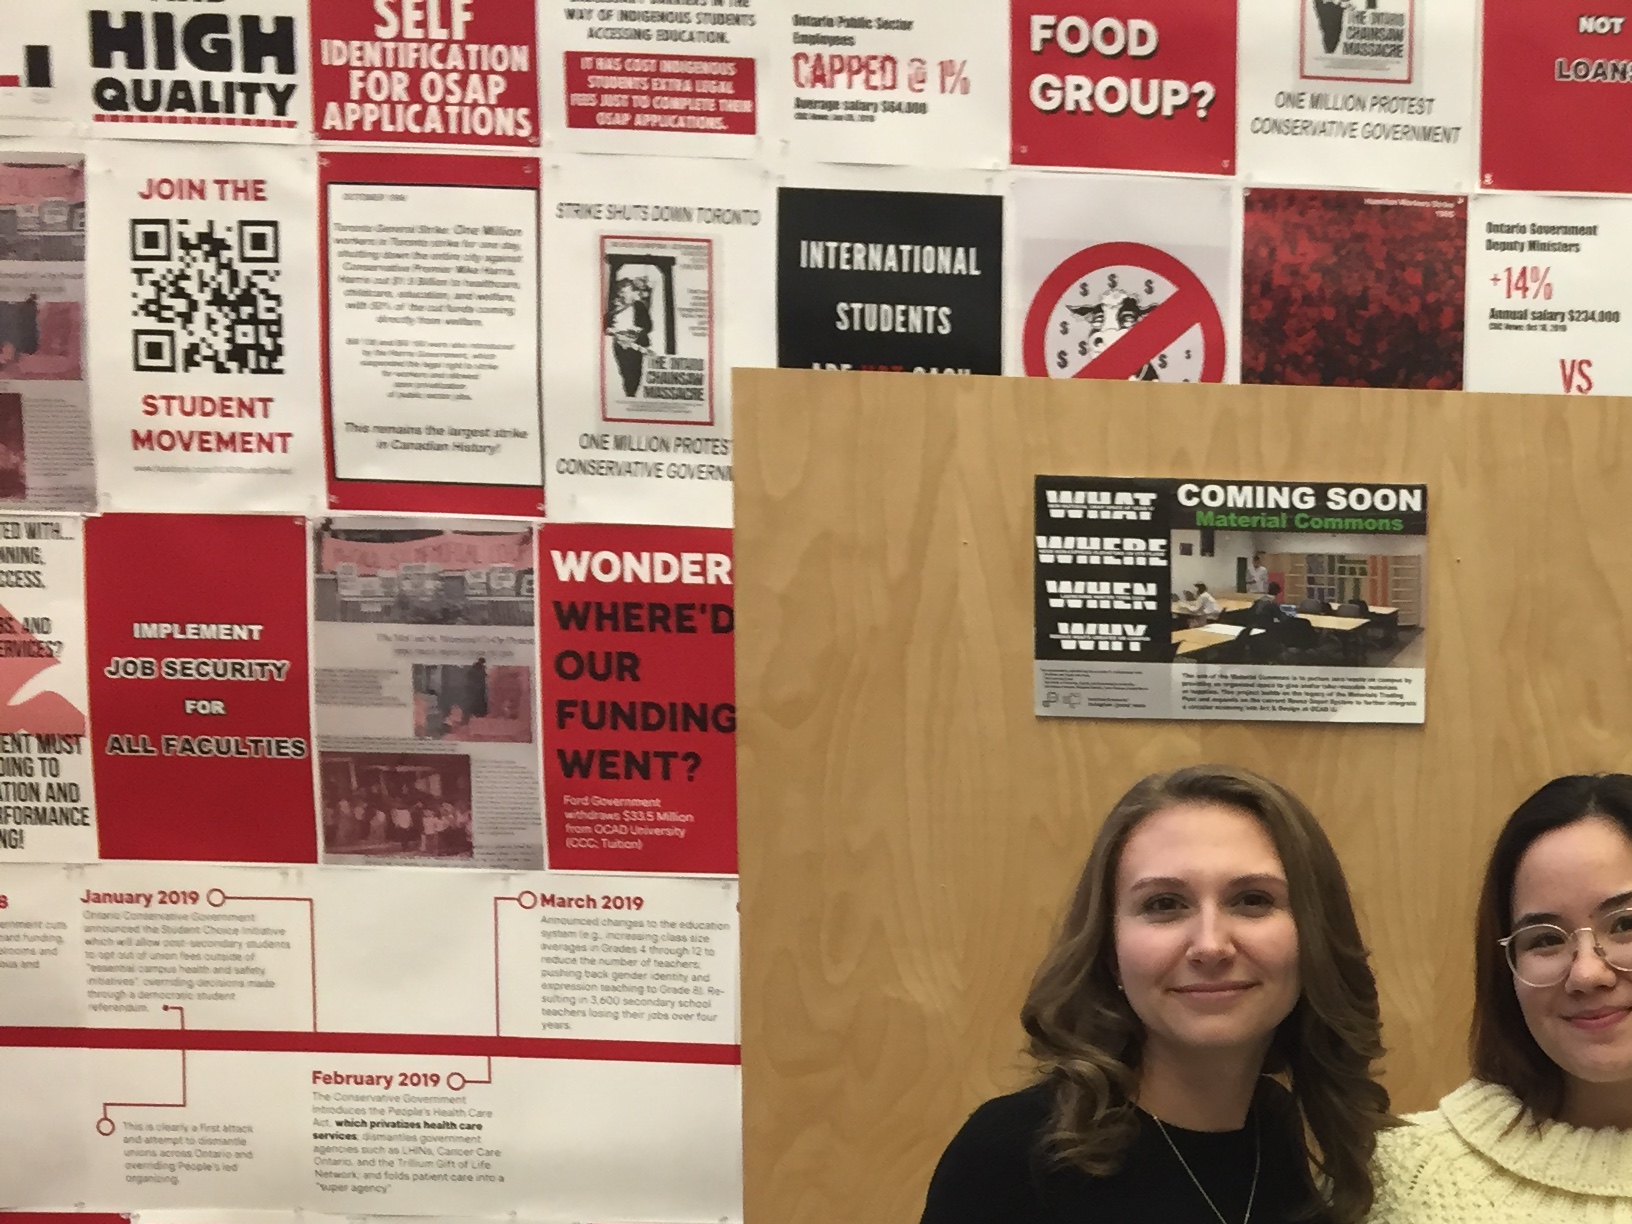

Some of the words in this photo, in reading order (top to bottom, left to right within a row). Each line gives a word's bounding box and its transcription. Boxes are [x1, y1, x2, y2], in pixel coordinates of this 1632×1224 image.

[138, 178, 206, 200] JOIN
[213, 179, 267, 201] THE
[143, 395, 274, 418] STUDENT
[131, 429, 292, 453] MOVEMENT
[1178, 484, 1315, 509] COMING
[1327, 488, 1421, 511] SOON
[1196, 511, 1288, 528] Material
[1295, 513, 1403, 530] Commons
[551, 551, 732, 584] WONDER
[553, 601, 734, 634] WHERE'D
[555, 650, 640, 681] OUR
[556, 700, 736, 733] FUNDING
[557, 749, 701, 781] WENT?
[80, 890, 153, 908] January
[158, 891, 199, 904] 2019
[541, 893, 597, 909] March
[602, 896, 644, 910] 2019
[312, 1071, 393, 1090] February
[399, 1073, 440, 1087] 2019
